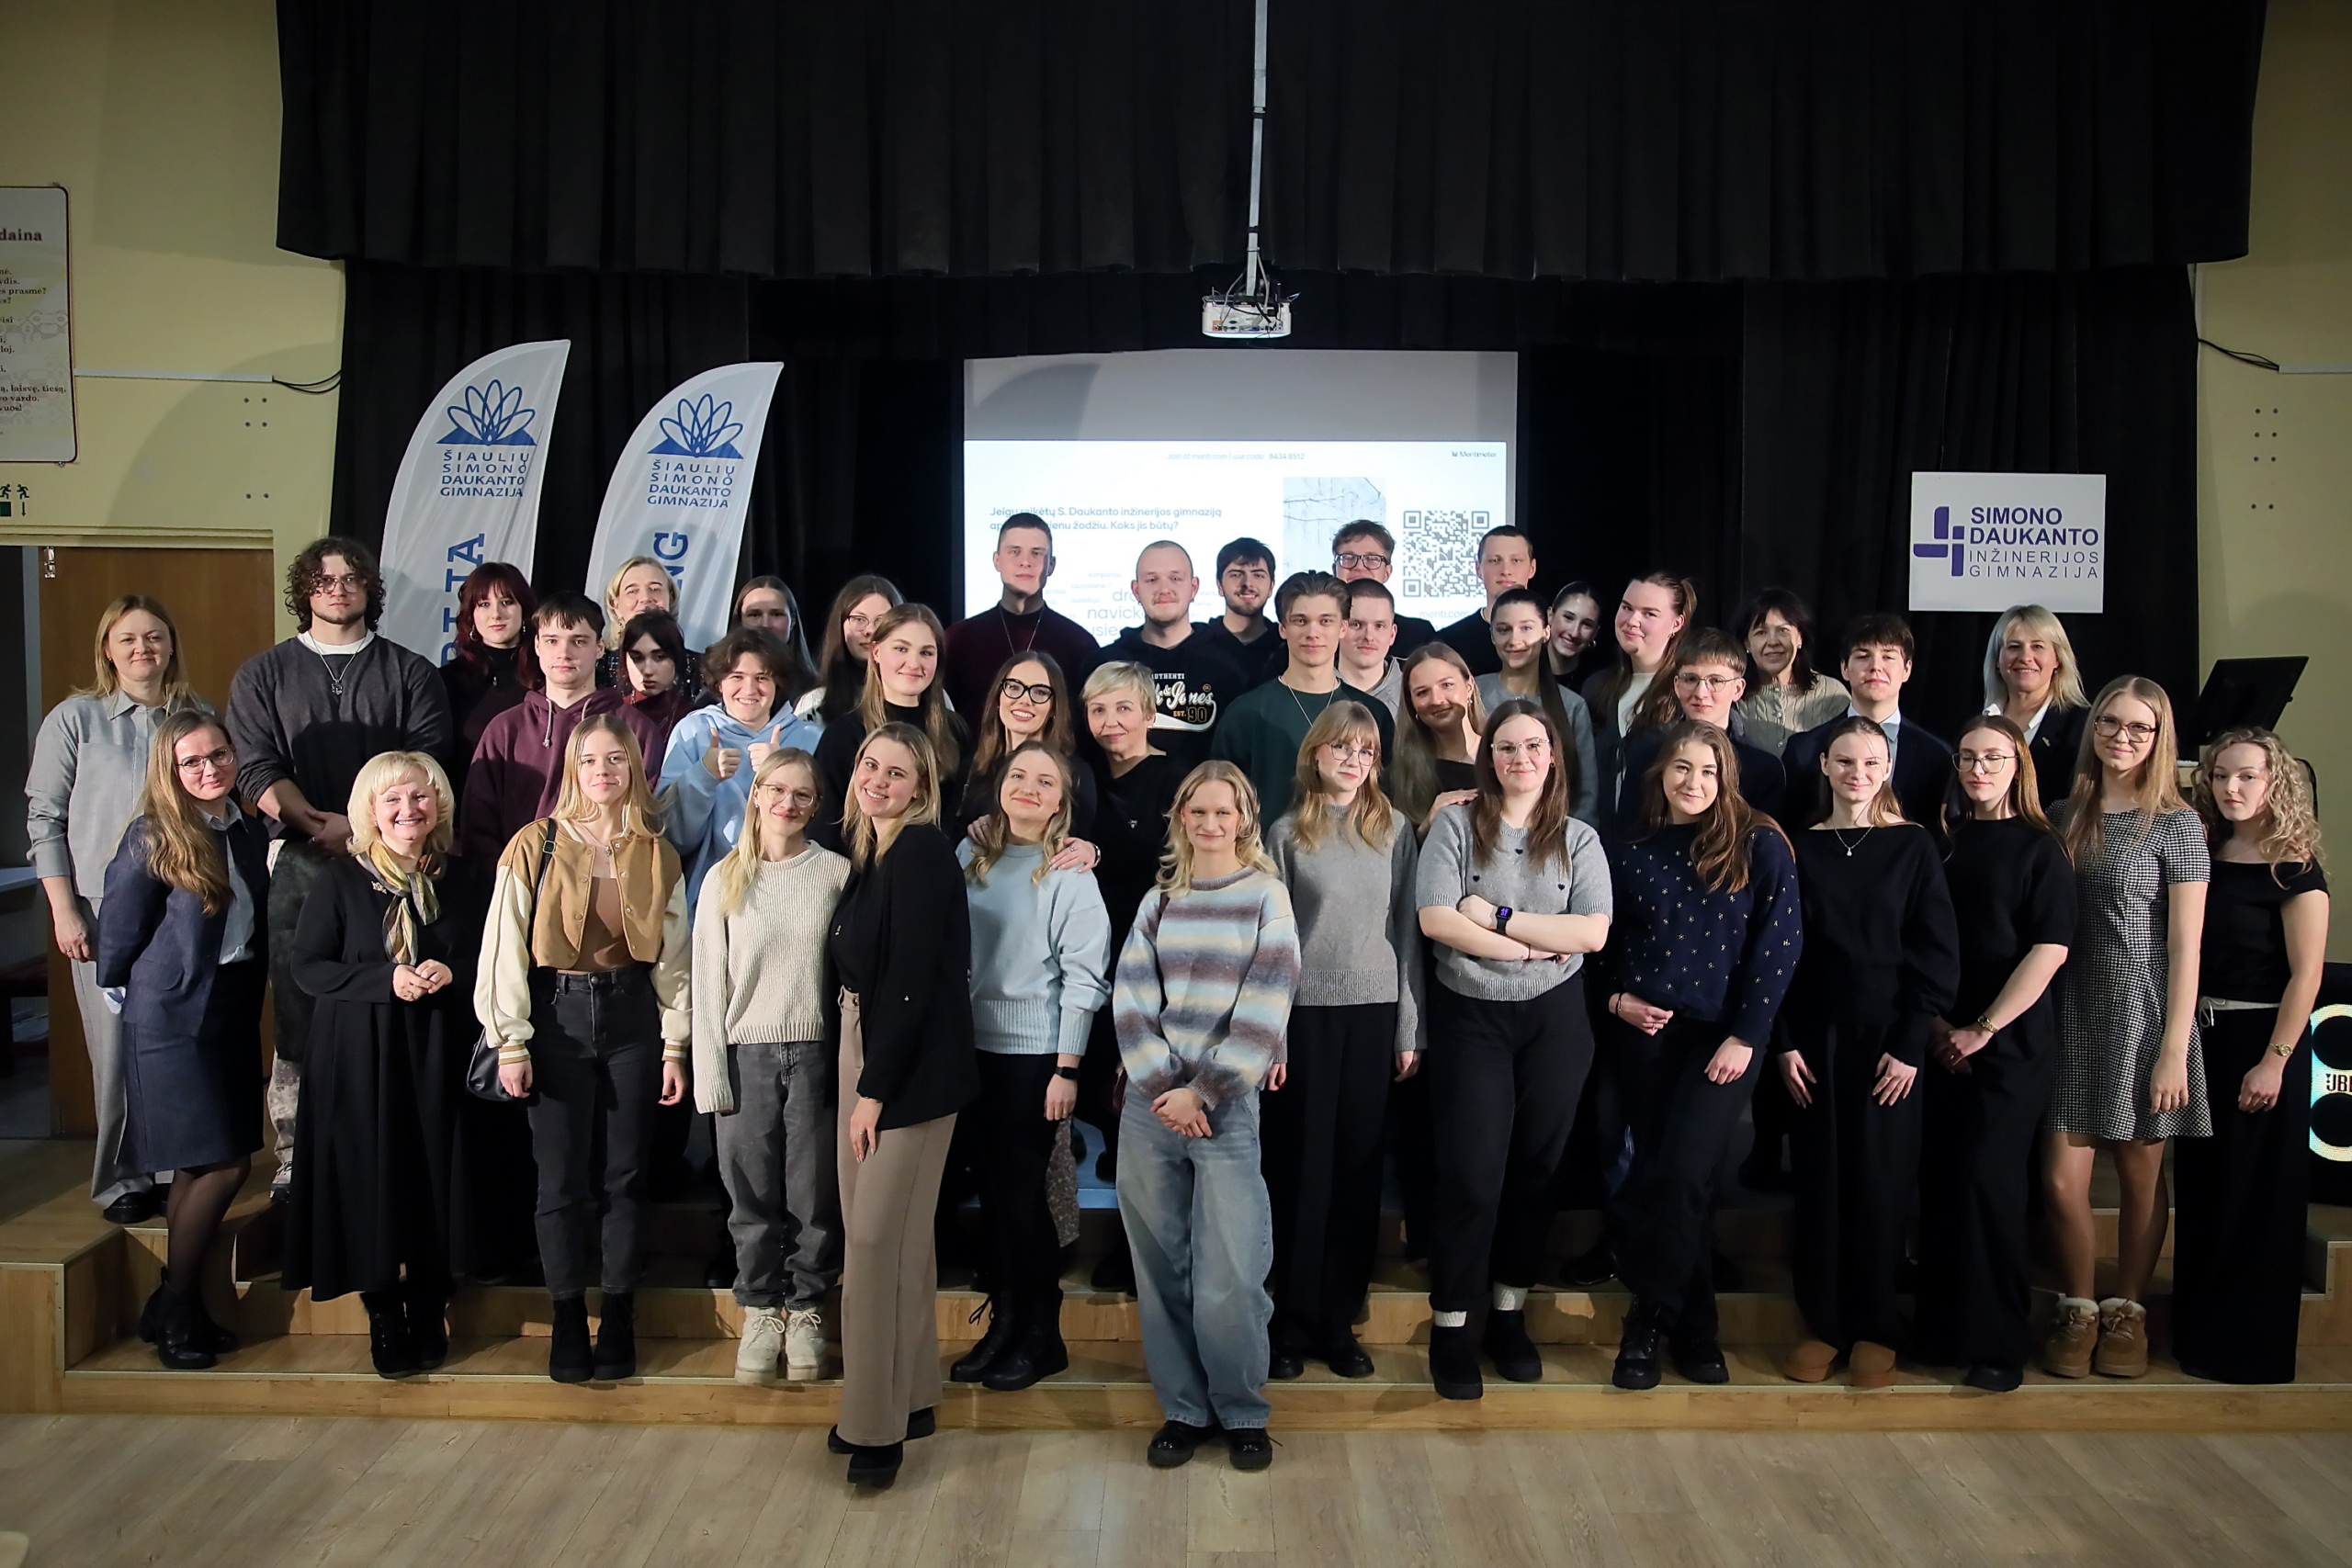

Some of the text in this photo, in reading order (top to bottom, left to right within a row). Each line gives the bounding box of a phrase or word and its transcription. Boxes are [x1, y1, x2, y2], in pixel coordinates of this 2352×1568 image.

[443, 449, 530, 465] ŠIAULIŲ
[442, 463, 527, 475] SIMONO
[651, 459, 735, 477] ŠIAULIŲ
[441, 475, 526, 486] DAUKANTO
[650, 472, 733, 486] SIMONO
[439, 486, 524, 498] GIMNAZIJA
[649, 484, 731, 497] DAUKANTO
[647, 495, 729, 509] GIMNAZIJA
[1057, 507, 1067, 515] S.
[1069, 506, 1119, 516] Daukanto
[1121, 507, 1171, 518] inžinerijos
[1173, 507, 1222, 518] gimnaziją
[1970, 507, 2063, 525] SIMONO
[1049, 520, 1179, 532] ienu žodžiu. Koks jis būtų?
[1969, 527, 2099, 547] DAUKANTO
[1969, 547, 2098, 564] INŽINERIJOS
[1969, 565, 2098, 579] GIMNAZIJA
[1087, 605, 1144, 620] navick
